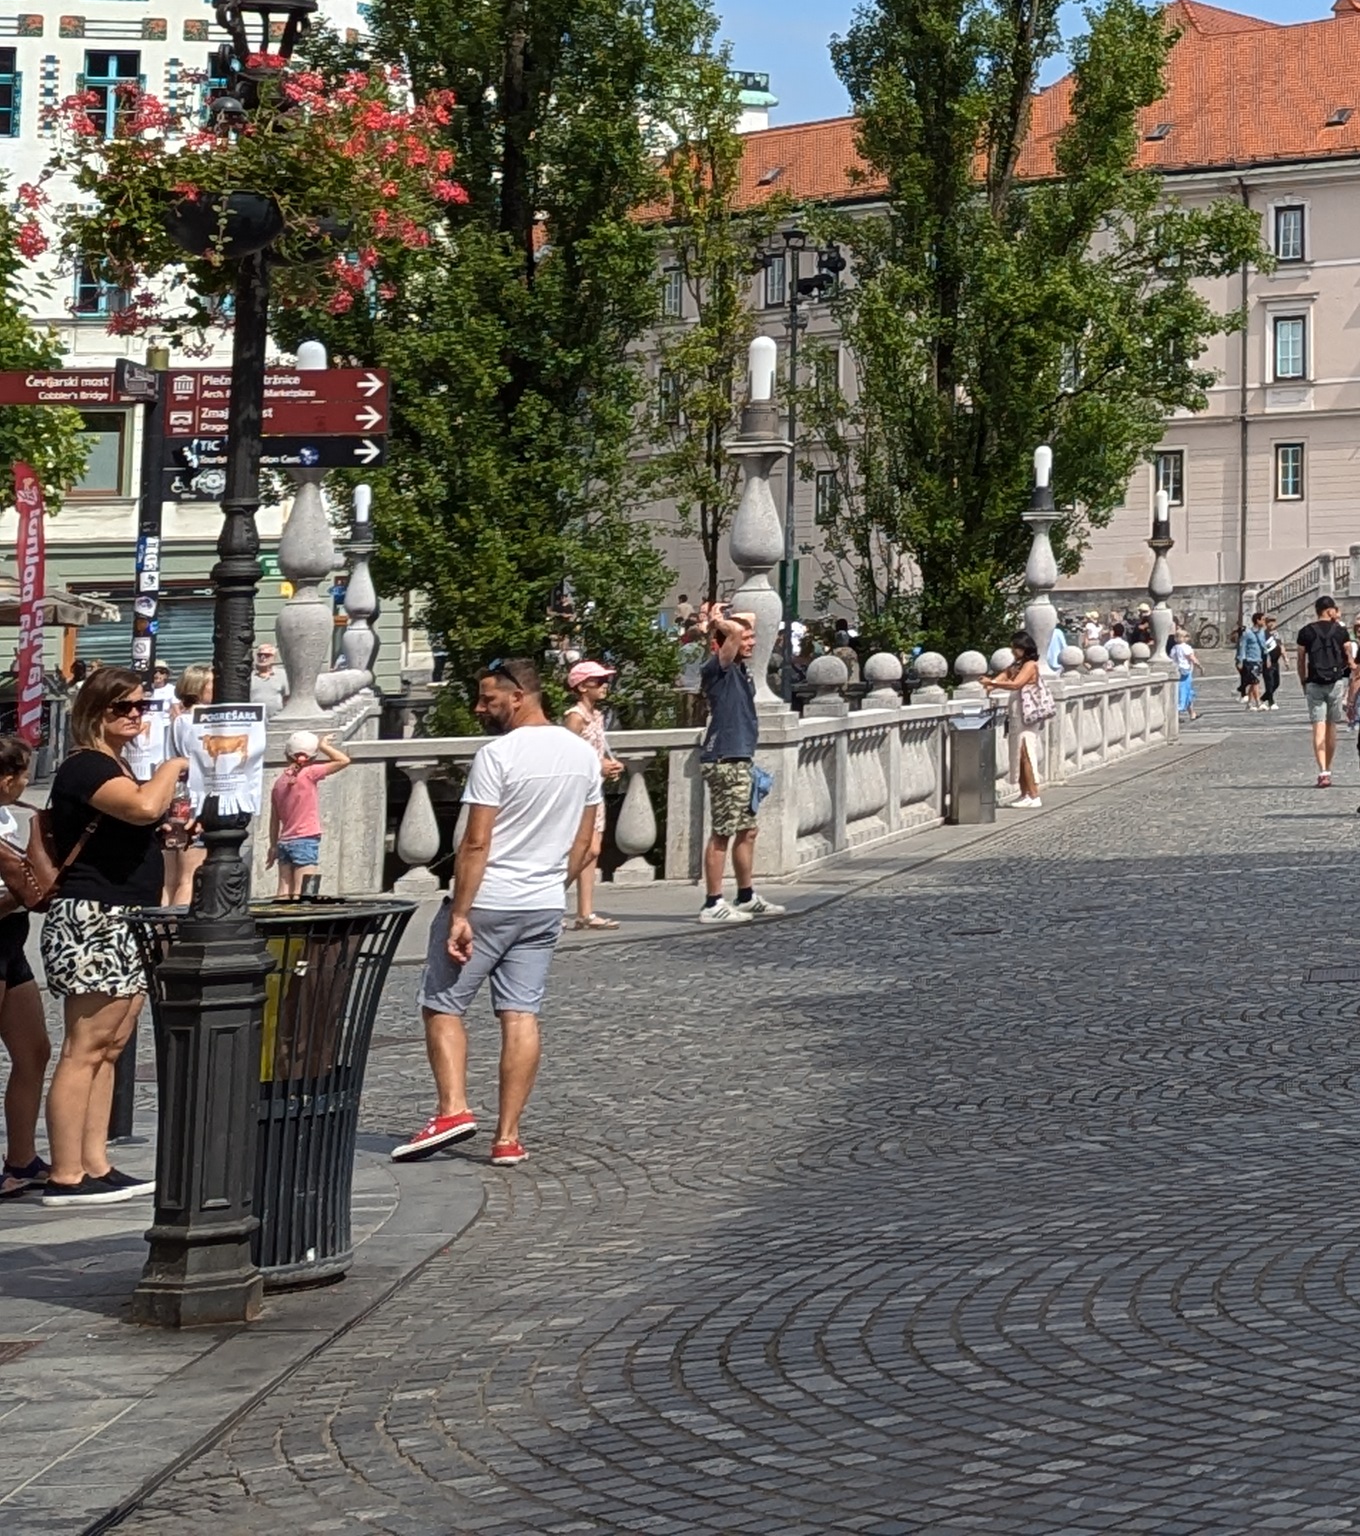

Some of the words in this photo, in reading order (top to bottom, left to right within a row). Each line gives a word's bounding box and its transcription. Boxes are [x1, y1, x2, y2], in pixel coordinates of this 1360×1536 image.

[25, 374, 78, 387] Čevarski
[81, 377, 109, 387] most
[202, 374, 232, 386] Plečn
[38, 391, 78, 400] Cobbler's
[80, 390, 109, 401] Bridge
[201, 407, 229, 420] Zmaj
[200, 422, 229, 433] Drago
[200, 440, 221, 451] TIC
